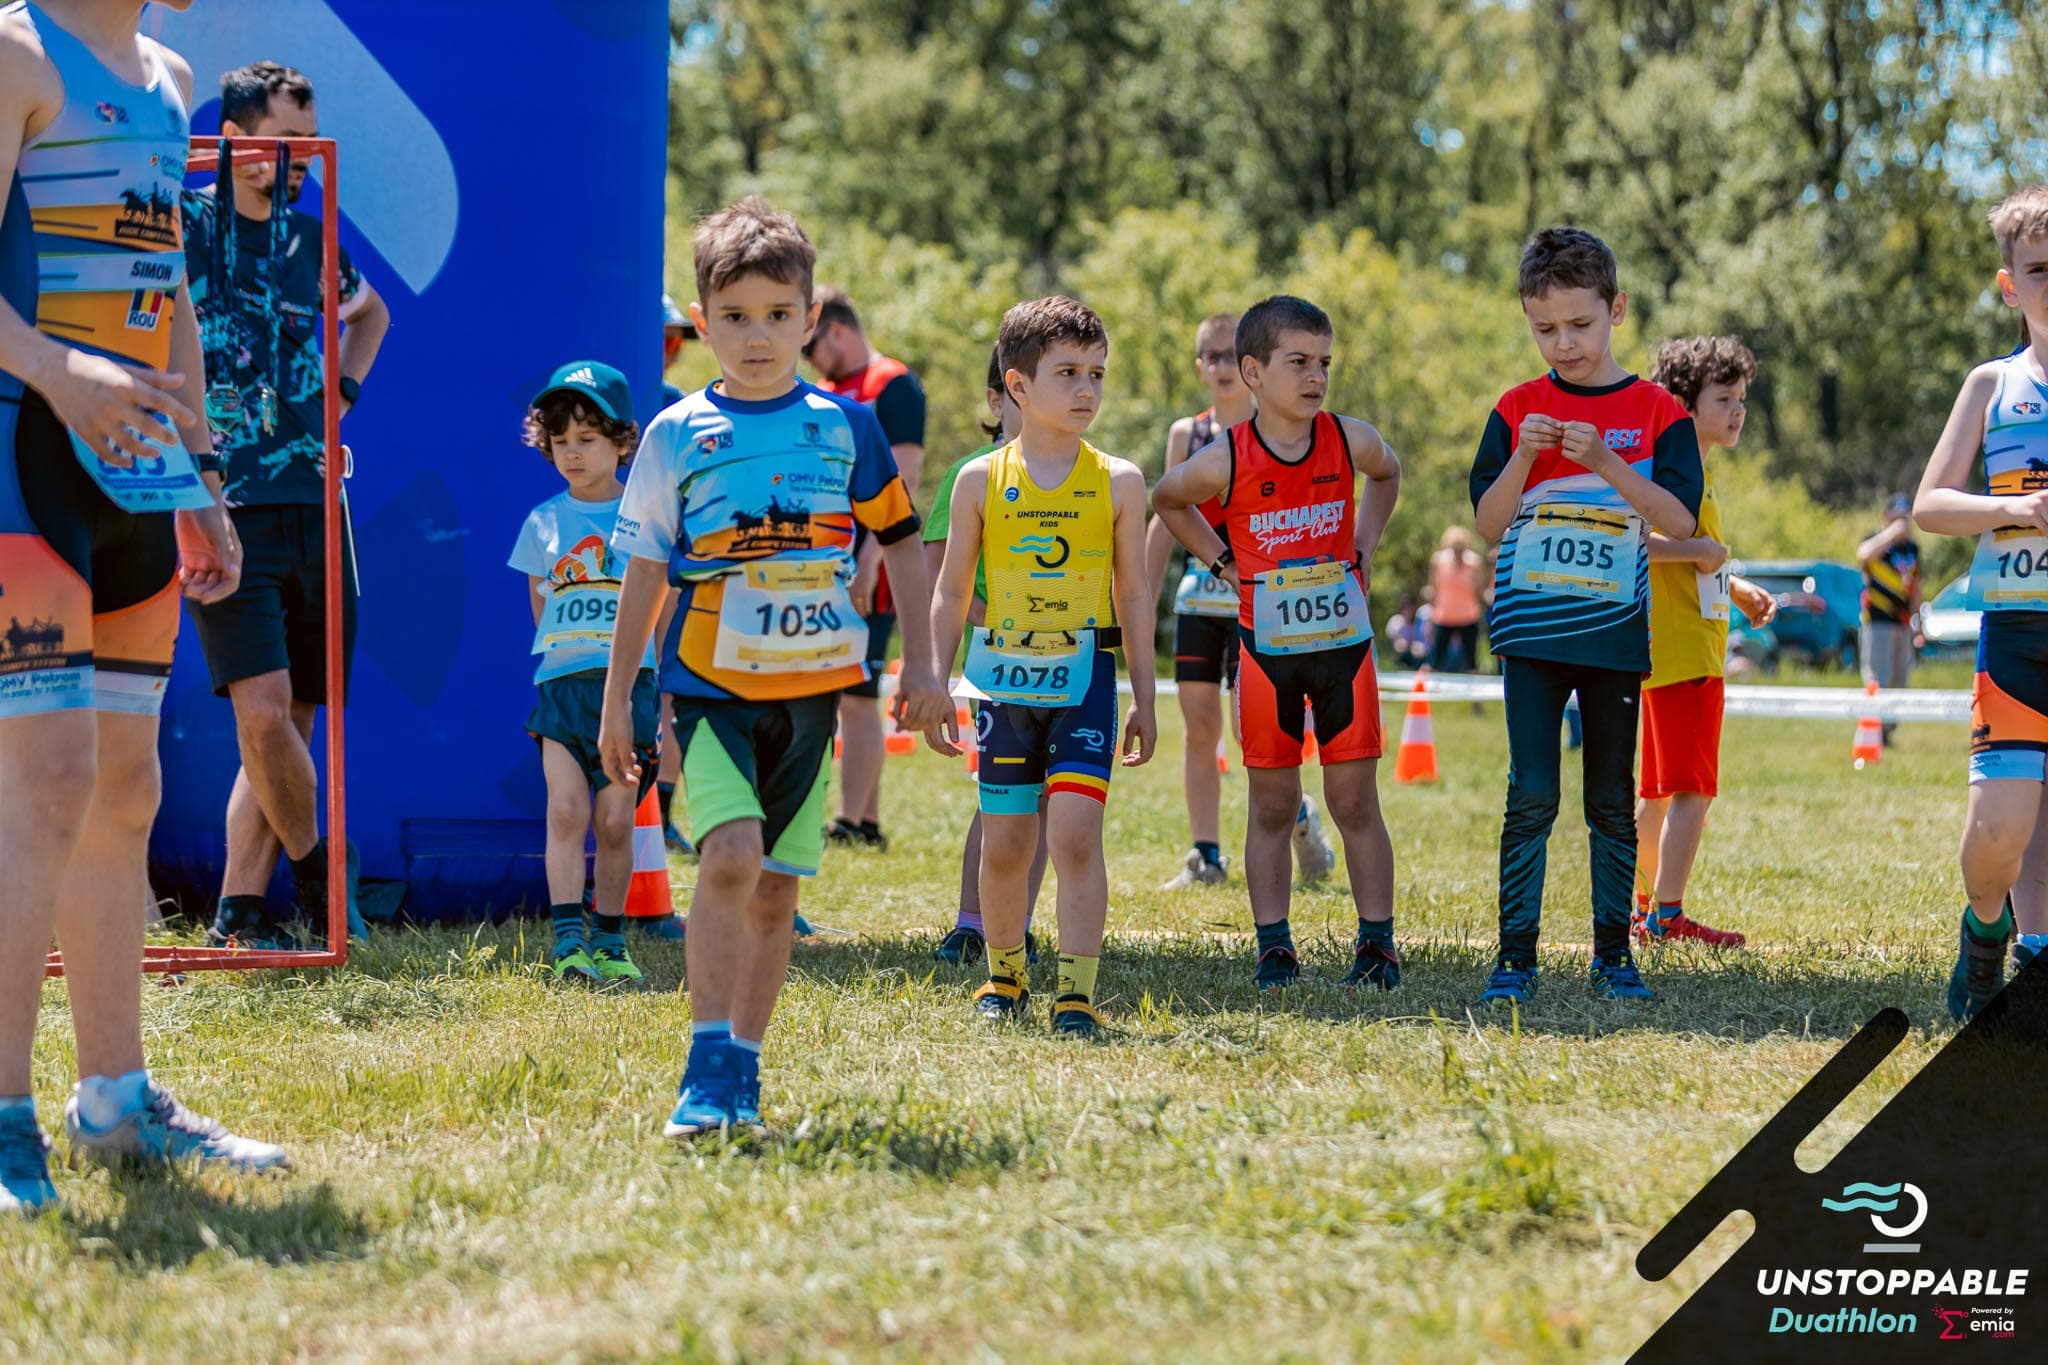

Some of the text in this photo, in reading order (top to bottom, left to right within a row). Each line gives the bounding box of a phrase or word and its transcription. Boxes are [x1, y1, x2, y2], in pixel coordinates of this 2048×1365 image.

[131, 260, 173, 281] SIMON
[128, 311, 157, 328] ROU
[1604, 428, 1642, 449] BSC
[1017, 511, 1080, 519] UNSTOPPABLE
[1249, 500, 1345, 533] BUCHAREST
[1256, 518, 1340, 555] Sport Club
[1540, 535, 1615, 570] 1035
[555, 597, 618, 625] 1099
[1044, 599, 1069, 609] emia
[1276, 591, 1349, 625] 1056
[756, 601, 842, 638] 1030
[31, 671, 81, 684] Petrom
[991, 663, 1070, 690] 1078
